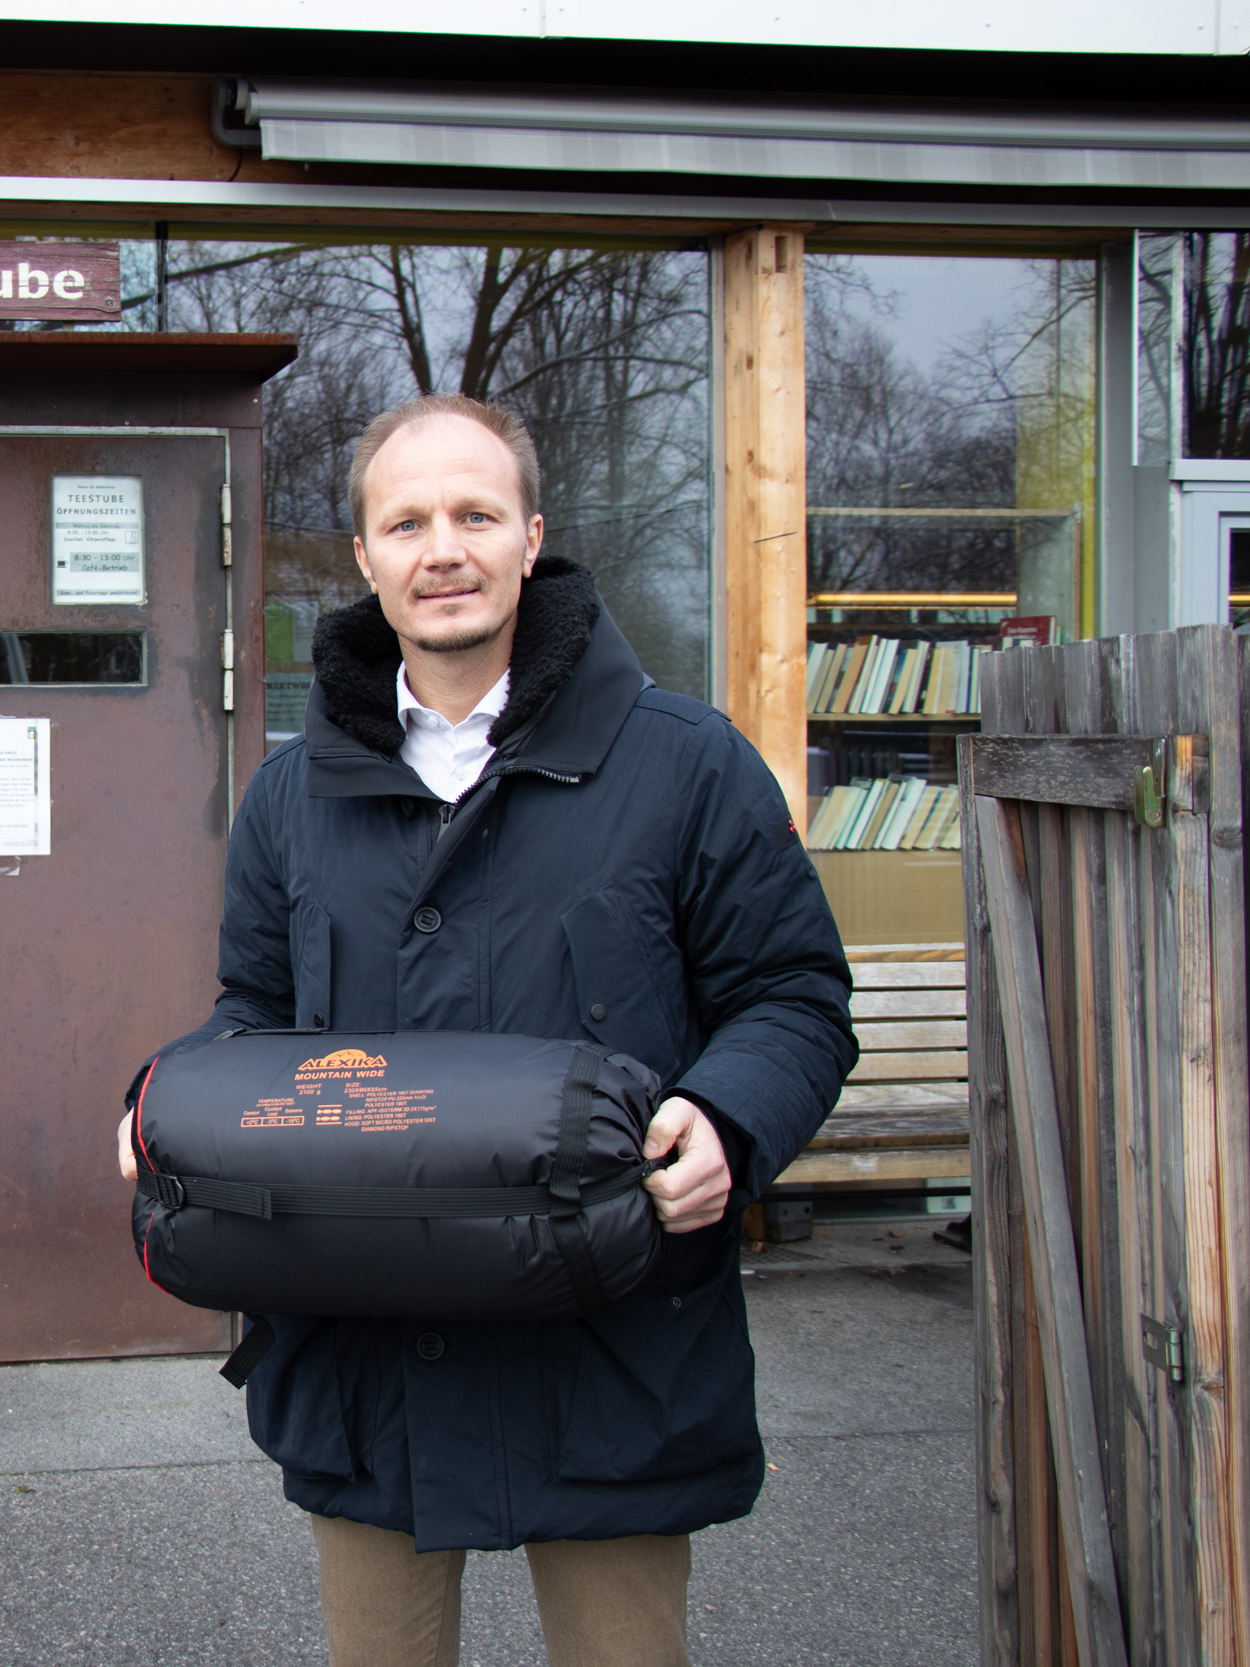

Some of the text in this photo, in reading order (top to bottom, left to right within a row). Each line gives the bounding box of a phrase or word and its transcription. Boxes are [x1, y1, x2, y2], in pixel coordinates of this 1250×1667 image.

[67, 494, 125, 503] TEESTUBE
[56, 506, 136, 515] ÖFFNUNGSZEITEN
[82, 563, 128, 572] Café-Betrieb
[298, 1055, 387, 1071] ALEXIKA
[294, 1069, 386, 1081] MOUNTAIN WIDE
